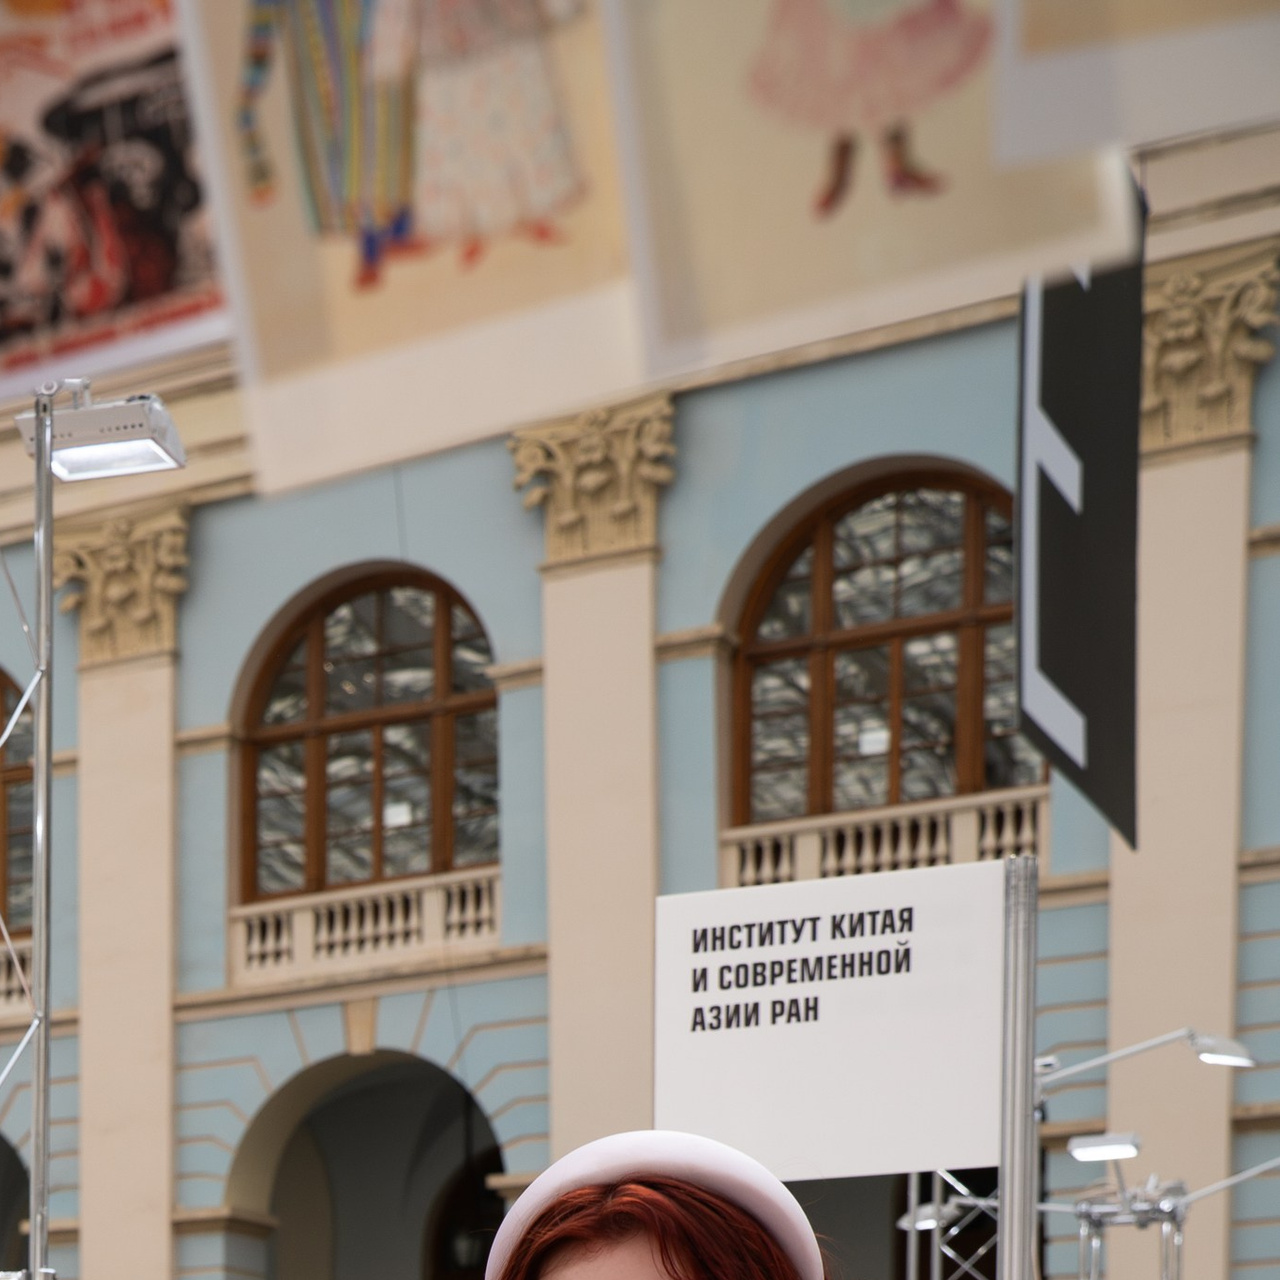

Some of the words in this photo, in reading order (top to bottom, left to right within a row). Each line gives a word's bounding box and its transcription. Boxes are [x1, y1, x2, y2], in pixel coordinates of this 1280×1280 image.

[691, 916, 821, 954] ИНСТИТУТ
[830, 906, 915, 941] КИТАЯ
[691, 967, 708, 994] И
[717, 939, 912, 991] СОВРЕМЕННОЙ
[690, 1002, 761, 1032] АЗИИ
[770, 996, 820, 1026] РАН
